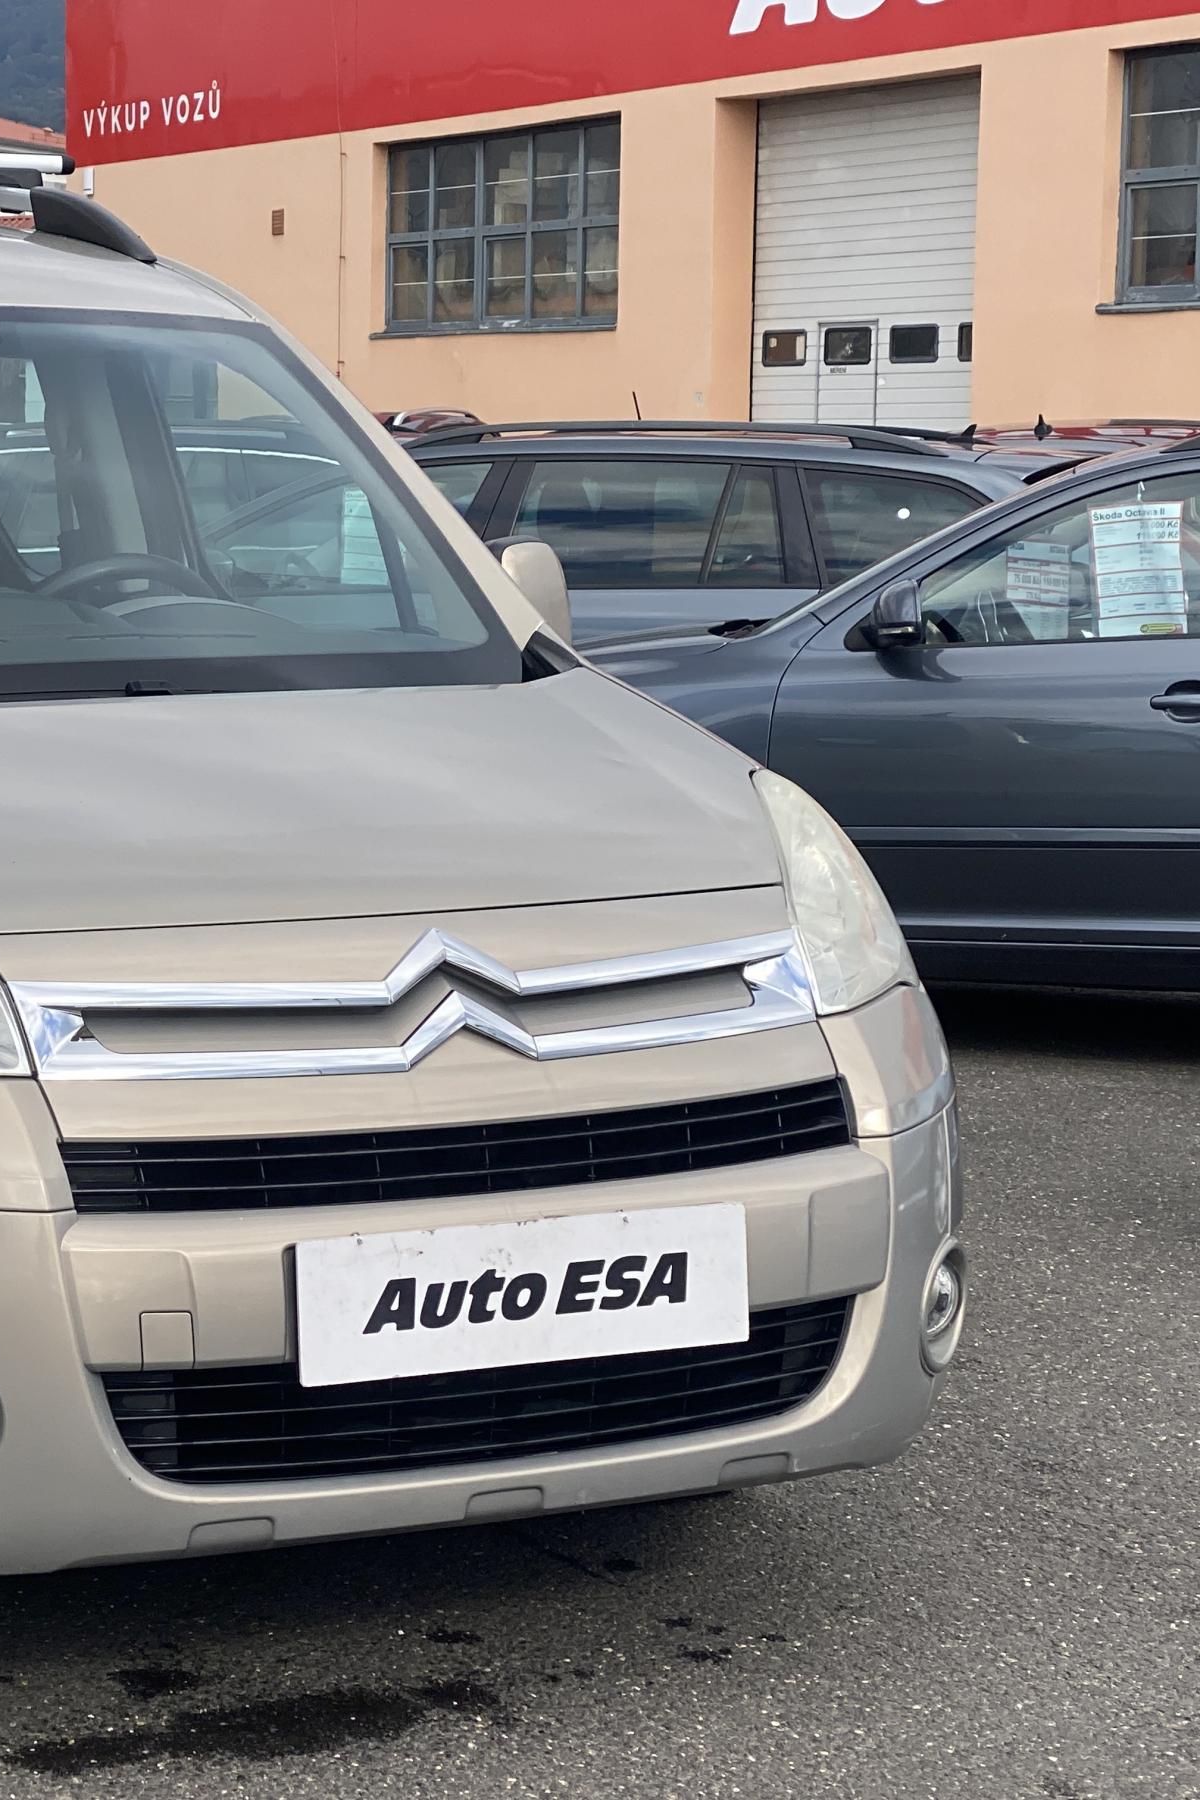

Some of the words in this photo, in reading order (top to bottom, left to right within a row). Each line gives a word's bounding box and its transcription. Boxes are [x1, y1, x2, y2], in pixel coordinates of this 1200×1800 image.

[83, 100, 151, 138] VÝKUP
[161, 79, 221, 127] VOZŮ
[1092, 509, 1122, 522] Škoda
[362, 1268, 547, 1335] Auto
[555, 1251, 689, 1316] ESA
